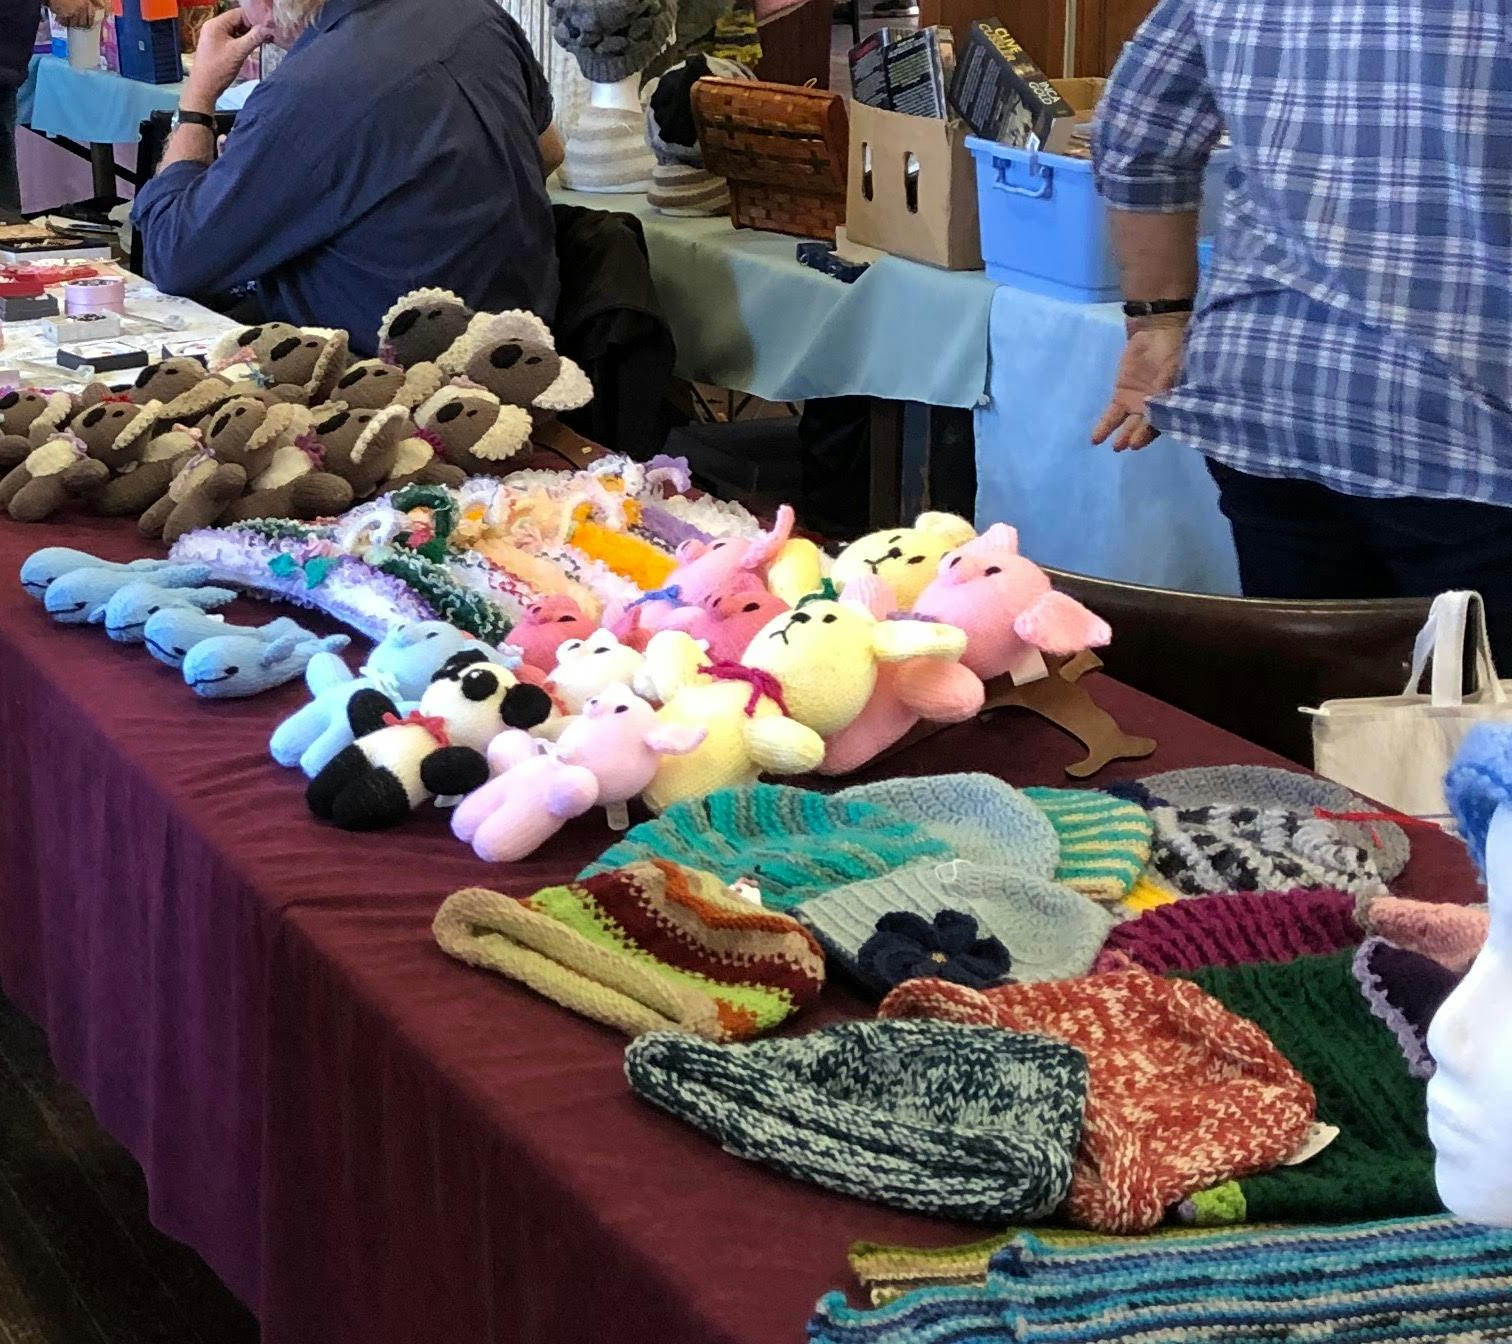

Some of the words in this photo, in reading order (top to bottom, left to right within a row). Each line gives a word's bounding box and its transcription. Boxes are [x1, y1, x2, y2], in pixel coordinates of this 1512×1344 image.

[994, 27, 1023, 54] CLIVE
[1028, 81, 1053, 105] GOLD
[1038, 81, 1061, 103] INCA
